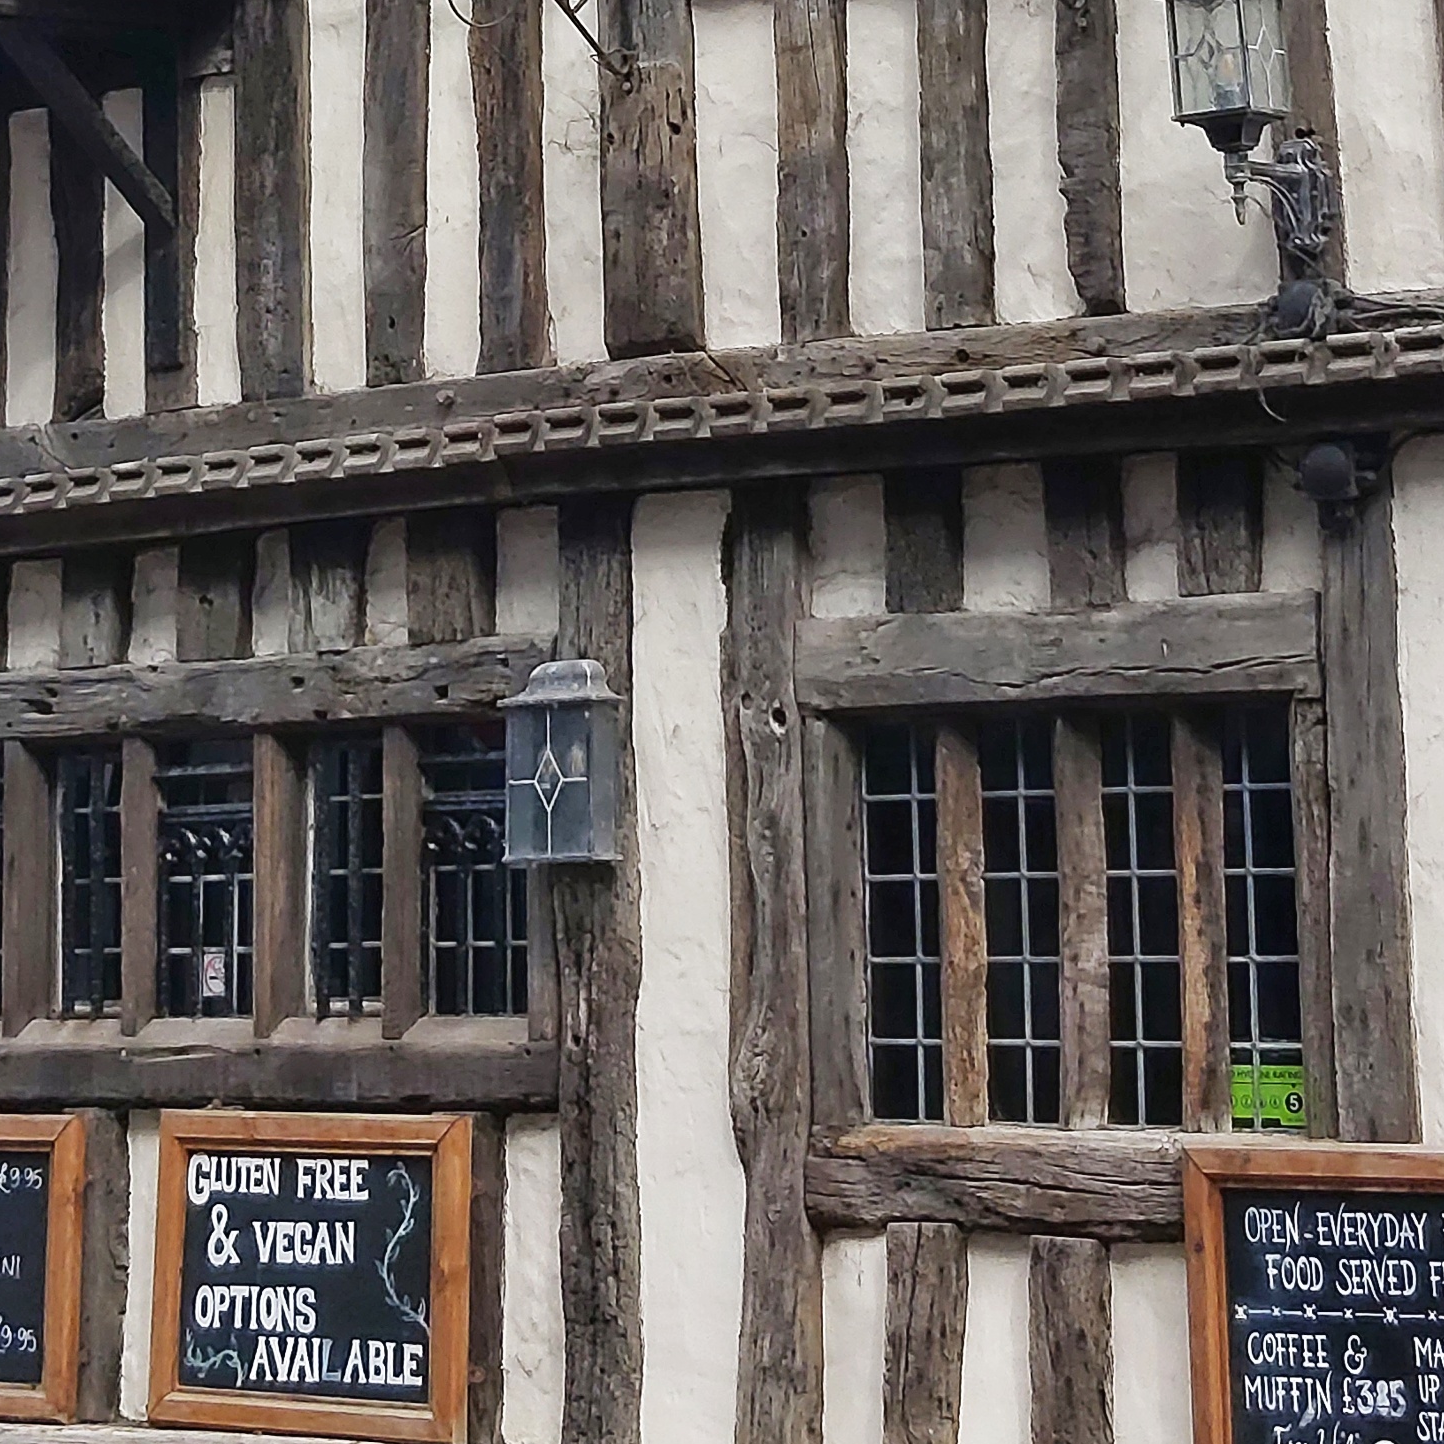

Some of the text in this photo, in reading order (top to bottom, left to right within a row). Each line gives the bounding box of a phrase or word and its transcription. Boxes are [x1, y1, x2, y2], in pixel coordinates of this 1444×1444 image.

[188, 1154, 369, 1205] GLUTEN FREE
[207, 1204, 356, 1267] & VEGAN
[1265, 1253, 1324, 1291] FOOD
[1335, 1255, 1417, 1303] SERVED
[195, 1284, 317, 1333] OPTIONS
[249, 1336, 423, 1386] AVAILABLE
[1247, 1332, 1368, 1375] COFFEE &
[1244, 1370, 1333, 1420] MUFFIN
[1418, 1375, 1441, 1405] UP
